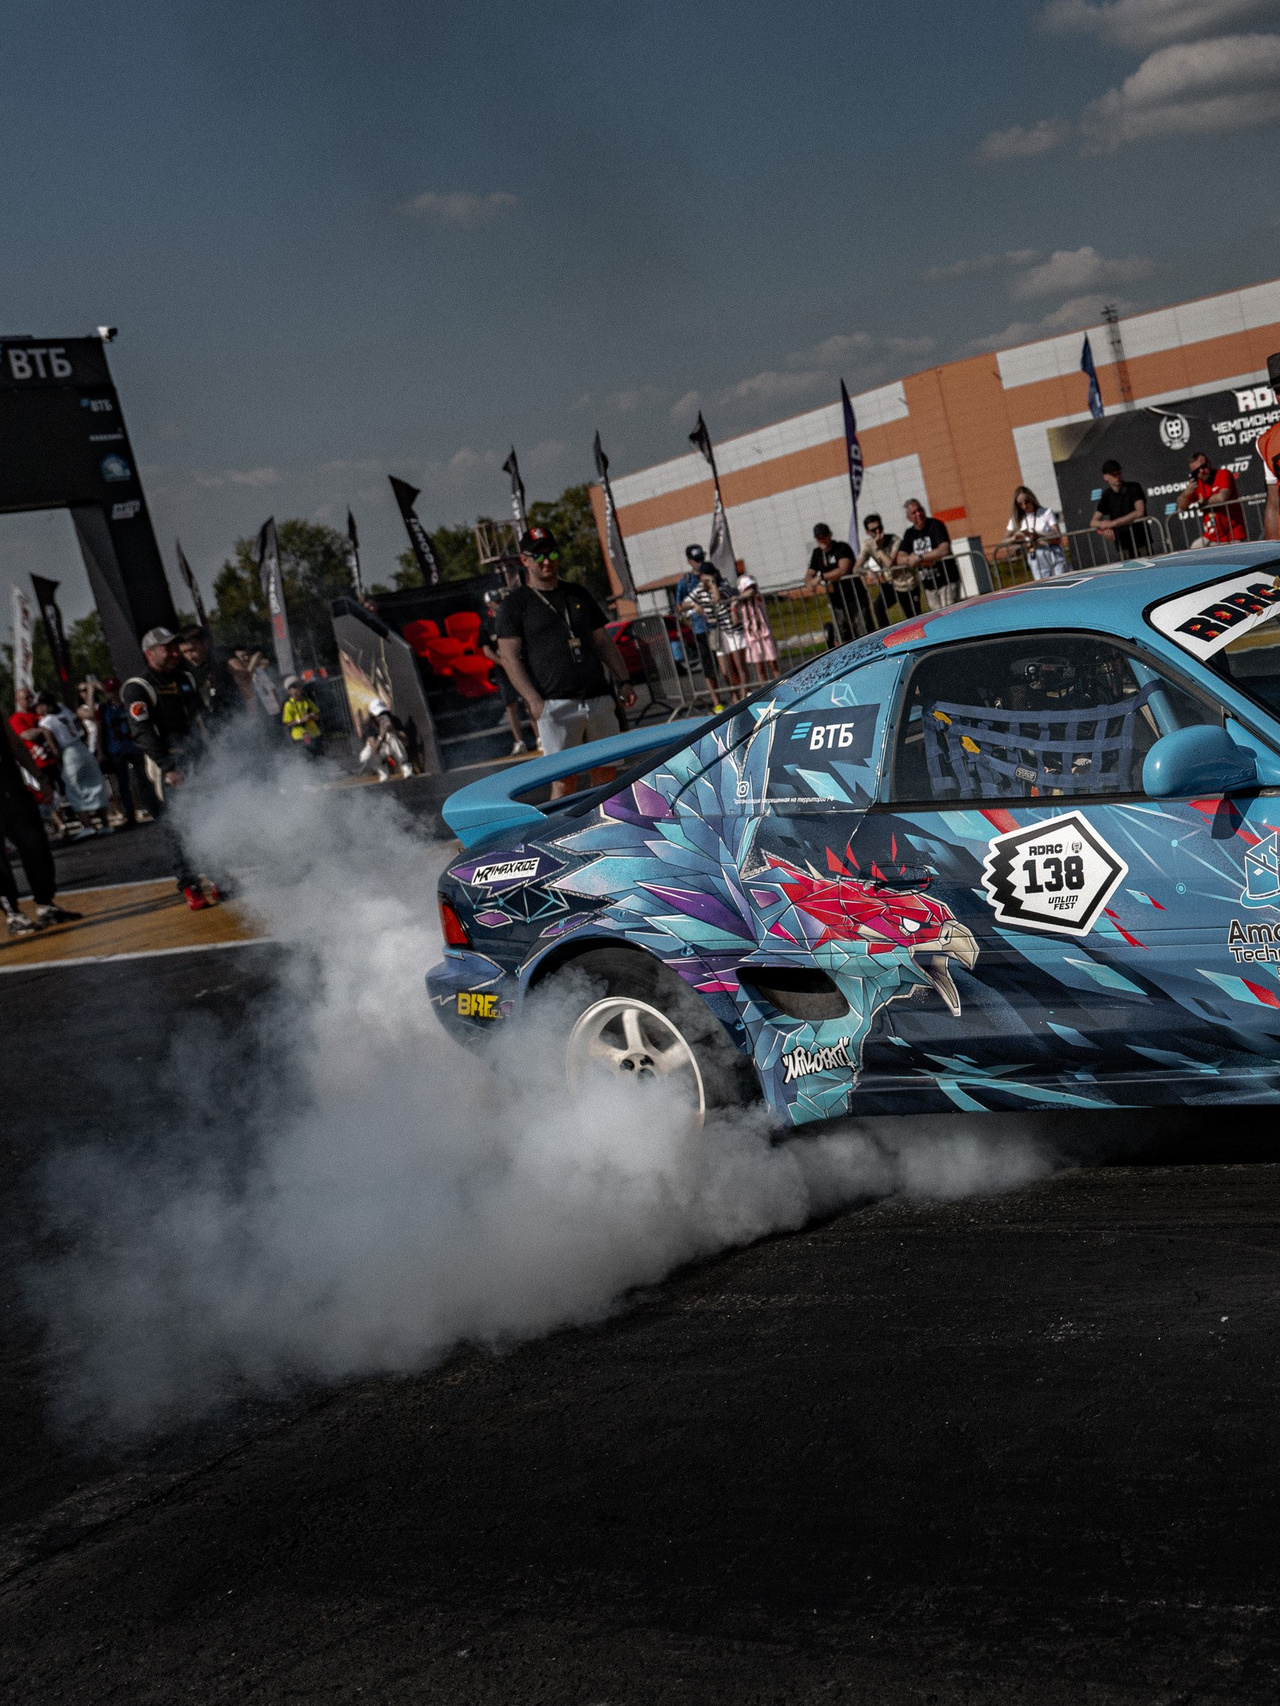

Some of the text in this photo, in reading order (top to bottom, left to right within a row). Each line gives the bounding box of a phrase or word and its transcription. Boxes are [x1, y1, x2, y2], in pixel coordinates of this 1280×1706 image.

[7, 347, 72, 380] ВТБ
[90, 398, 113, 412] ВТБ
[1231, 386, 1279, 413] RD
[1218, 432, 1237, 447] ПО
[810, 722, 855, 751] ВТБ
[1028, 844, 1063, 856] RDRC
[1022, 855, 1085, 894] 138
[1053, 903, 1076, 911] FEST
